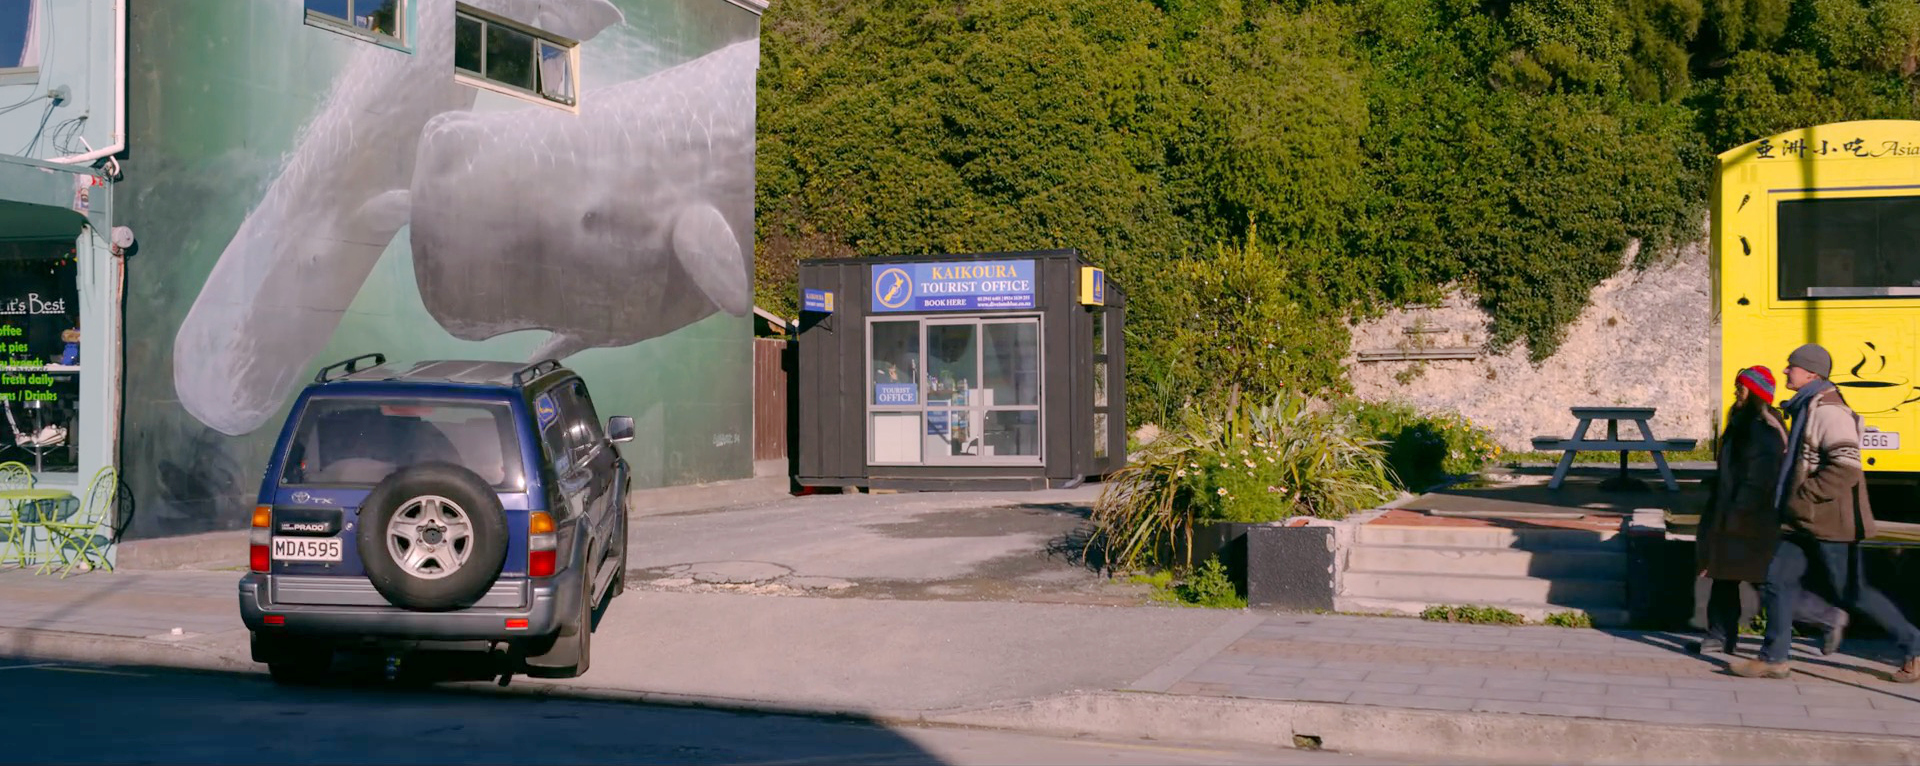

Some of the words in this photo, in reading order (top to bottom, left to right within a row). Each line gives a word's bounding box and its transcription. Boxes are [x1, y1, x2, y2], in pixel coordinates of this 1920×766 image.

[932, 264, 1017, 280] KAIKOURA
[921, 281, 977, 293] TOURIST
[981, 280, 1029, 292] OFFICE
[28, 293, 65, 314] Best
[924, 299, 946, 307] BOOK
[0, 325, 22, 336] ffee
[9, 341, 28, 354] pies
[1, 373, 26, 384] fresh
[28, 373, 54, 387] daily
[24, 390, 57, 400] Drinks
[879, 393, 914, 402] OFFICE
[1862, 434, 1888, 447] 66G
[294, 523, 325, 531] PRADO
[275, 540, 339, 557] MDA595
